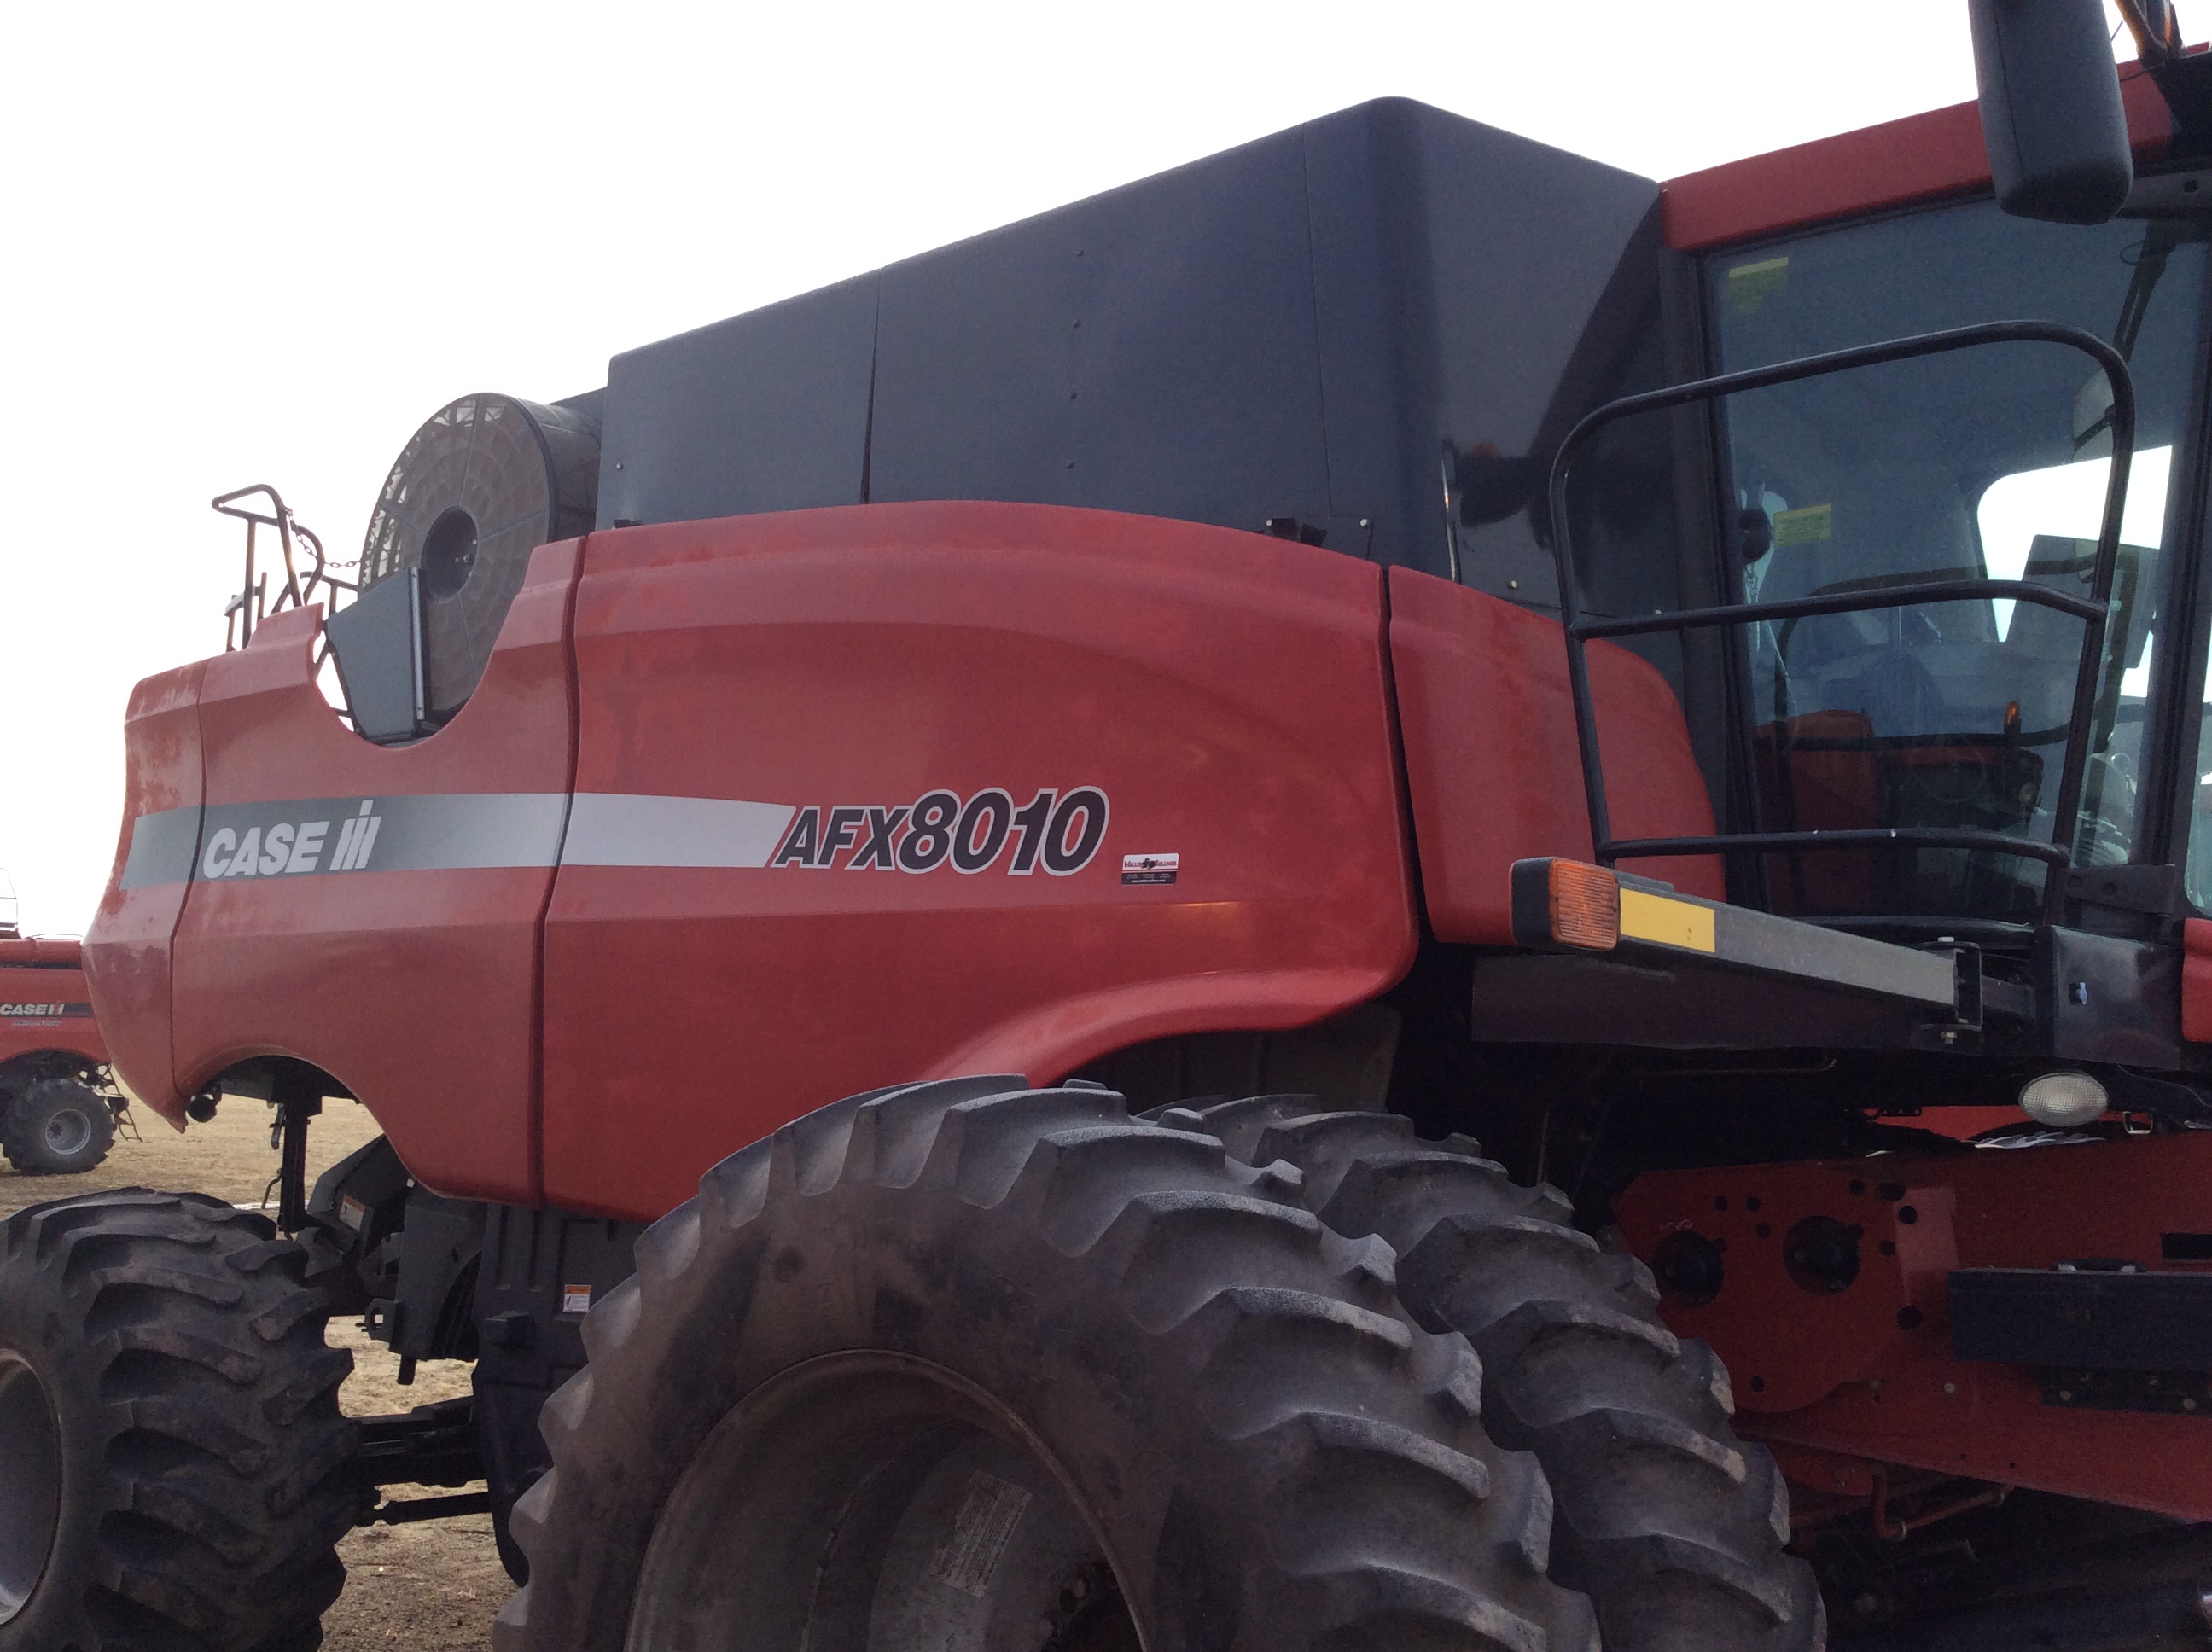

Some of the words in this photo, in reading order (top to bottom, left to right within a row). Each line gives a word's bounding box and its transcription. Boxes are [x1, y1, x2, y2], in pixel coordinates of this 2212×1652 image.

[203, 821, 330, 879] CASE
[771, 785, 1109, 876] AFX8010
[0, 1003, 48, 1015] CASE
